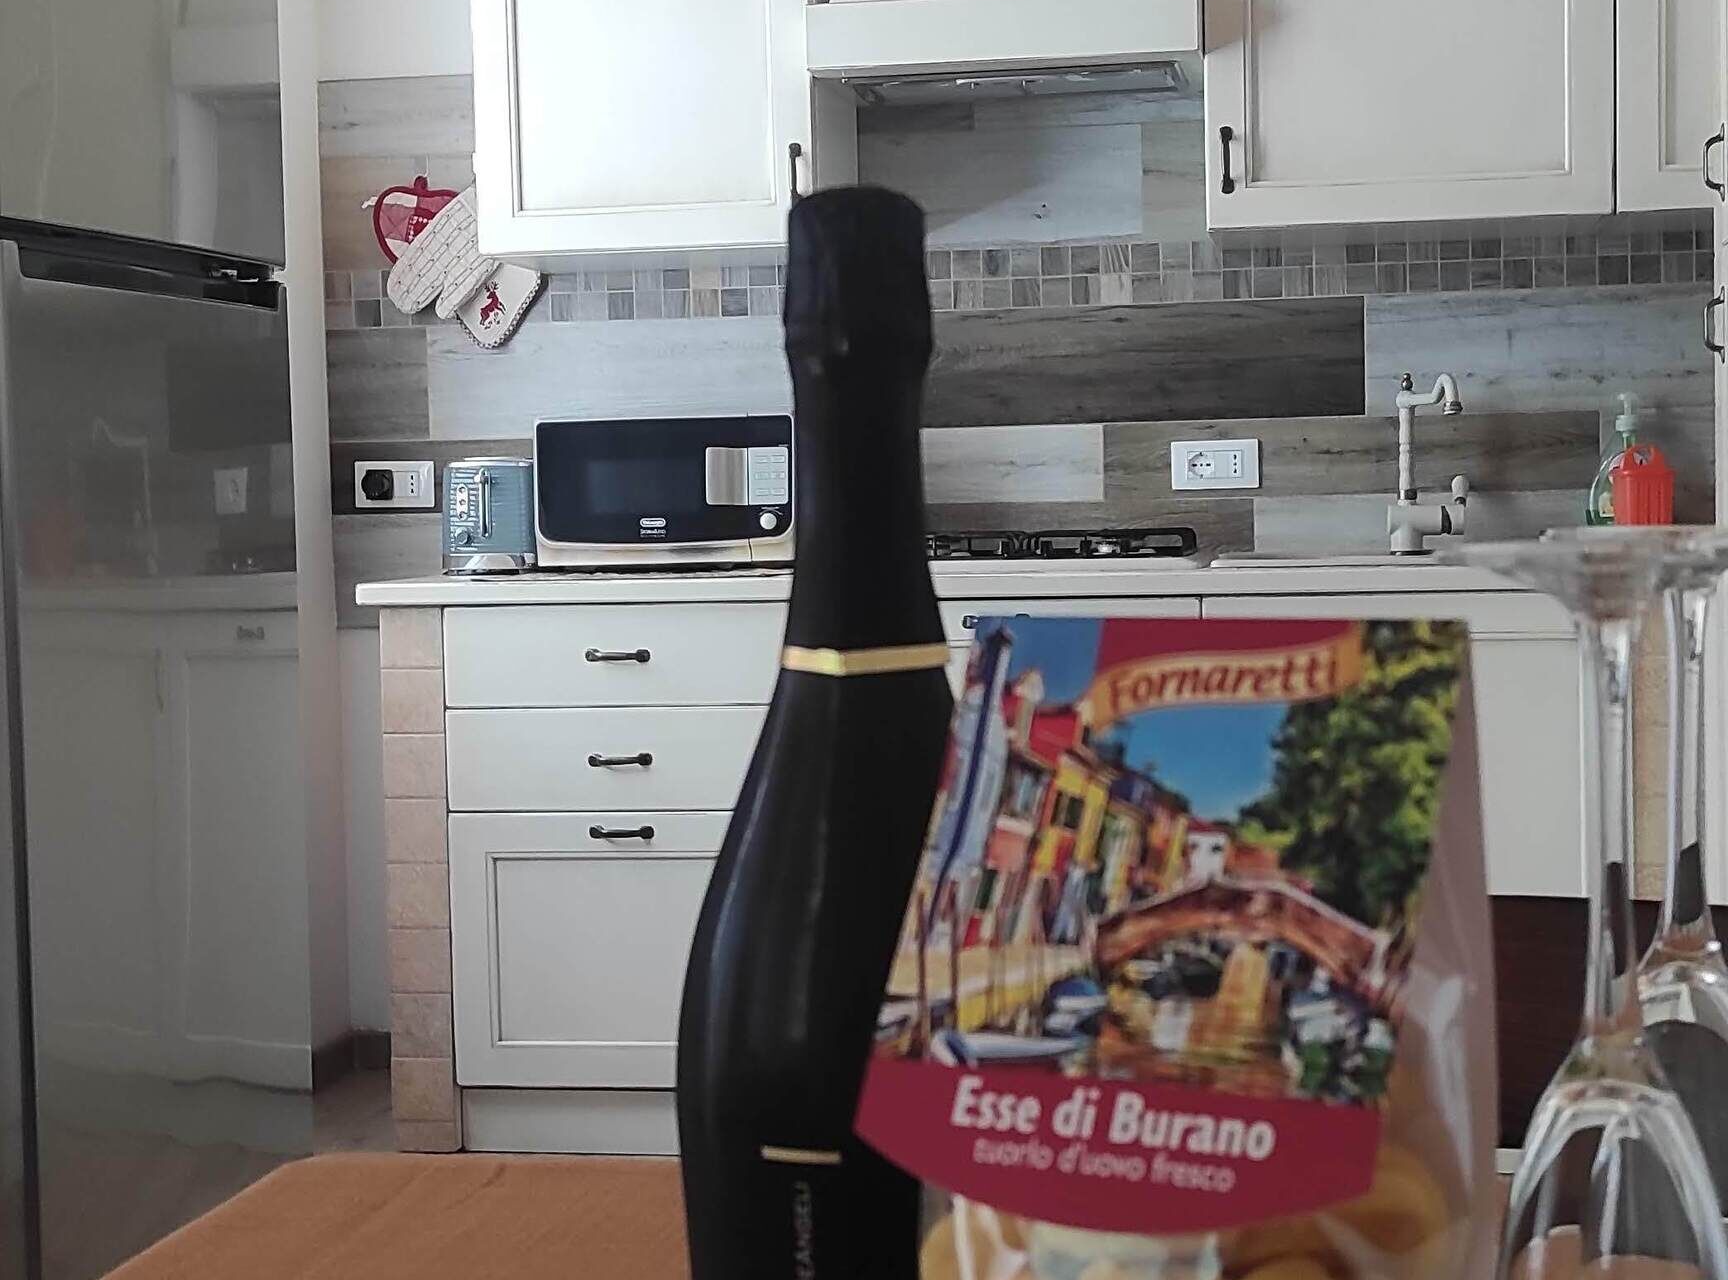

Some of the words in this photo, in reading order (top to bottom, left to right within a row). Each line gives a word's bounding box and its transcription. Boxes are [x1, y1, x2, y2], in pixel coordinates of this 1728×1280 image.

[1109, 646, 1339, 713] Fornaretti
[951, 1074, 1042, 1133] Esse
[1052, 1085, 1101, 1140] di
[1108, 1091, 1277, 1161] Burano
[1057, 1141, 1147, 1182] d'uovo
[1150, 1150, 1236, 1194] fresco
